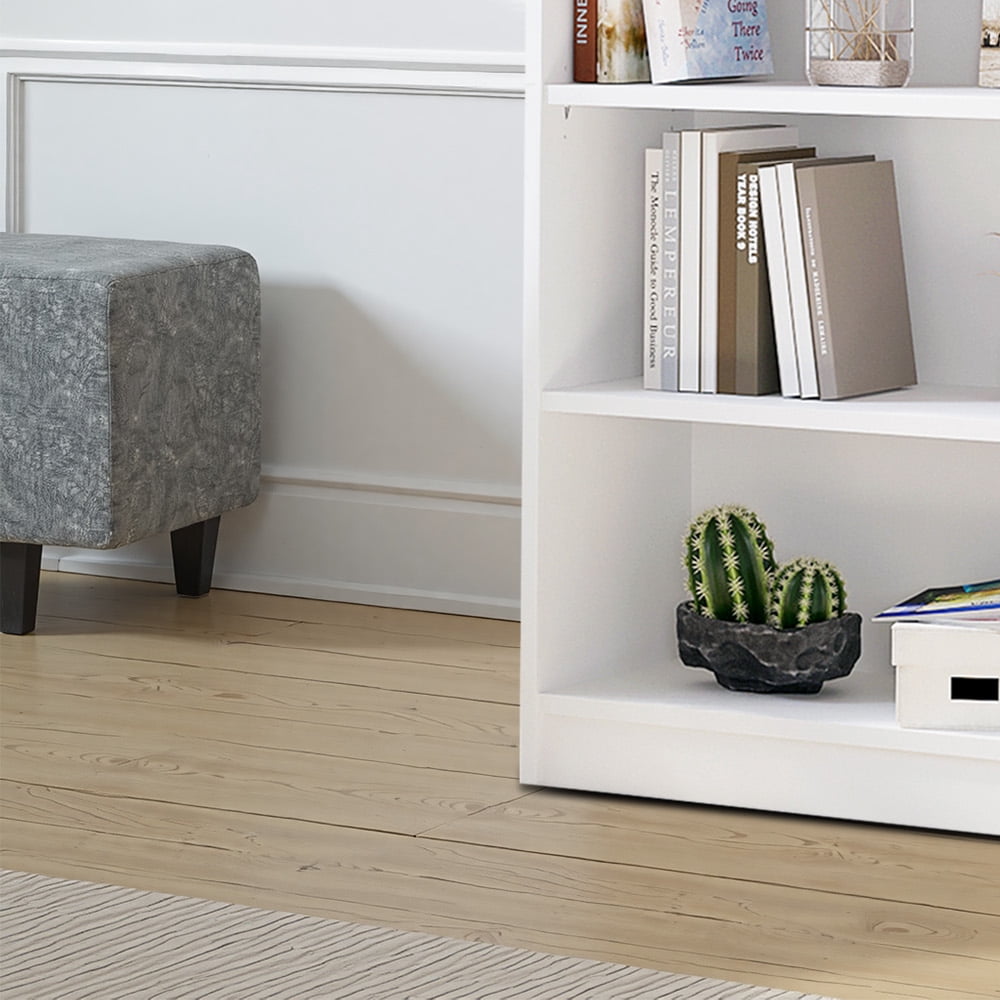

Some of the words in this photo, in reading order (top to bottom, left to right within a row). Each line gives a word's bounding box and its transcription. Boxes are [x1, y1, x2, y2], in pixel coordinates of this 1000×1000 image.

[732, 20, 761, 37] There
[734, 45, 764, 61] Twice
[650, 171, 660, 192] The
[736, 174, 747, 205] YEAR
[748, 174, 759, 217] DESIGN
[650, 196, 659, 241] Monocle
[736, 207, 747, 240] BOOK
[736, 241, 747, 250] 9
[747, 219, 759, 264] HOTELS
[650, 244, 659, 276] Guide
[663, 190, 678, 359] LEMPEREUR
[650, 279, 657, 289] to
[649, 292, 659, 321] Good
[649, 325, 659, 369] Business
